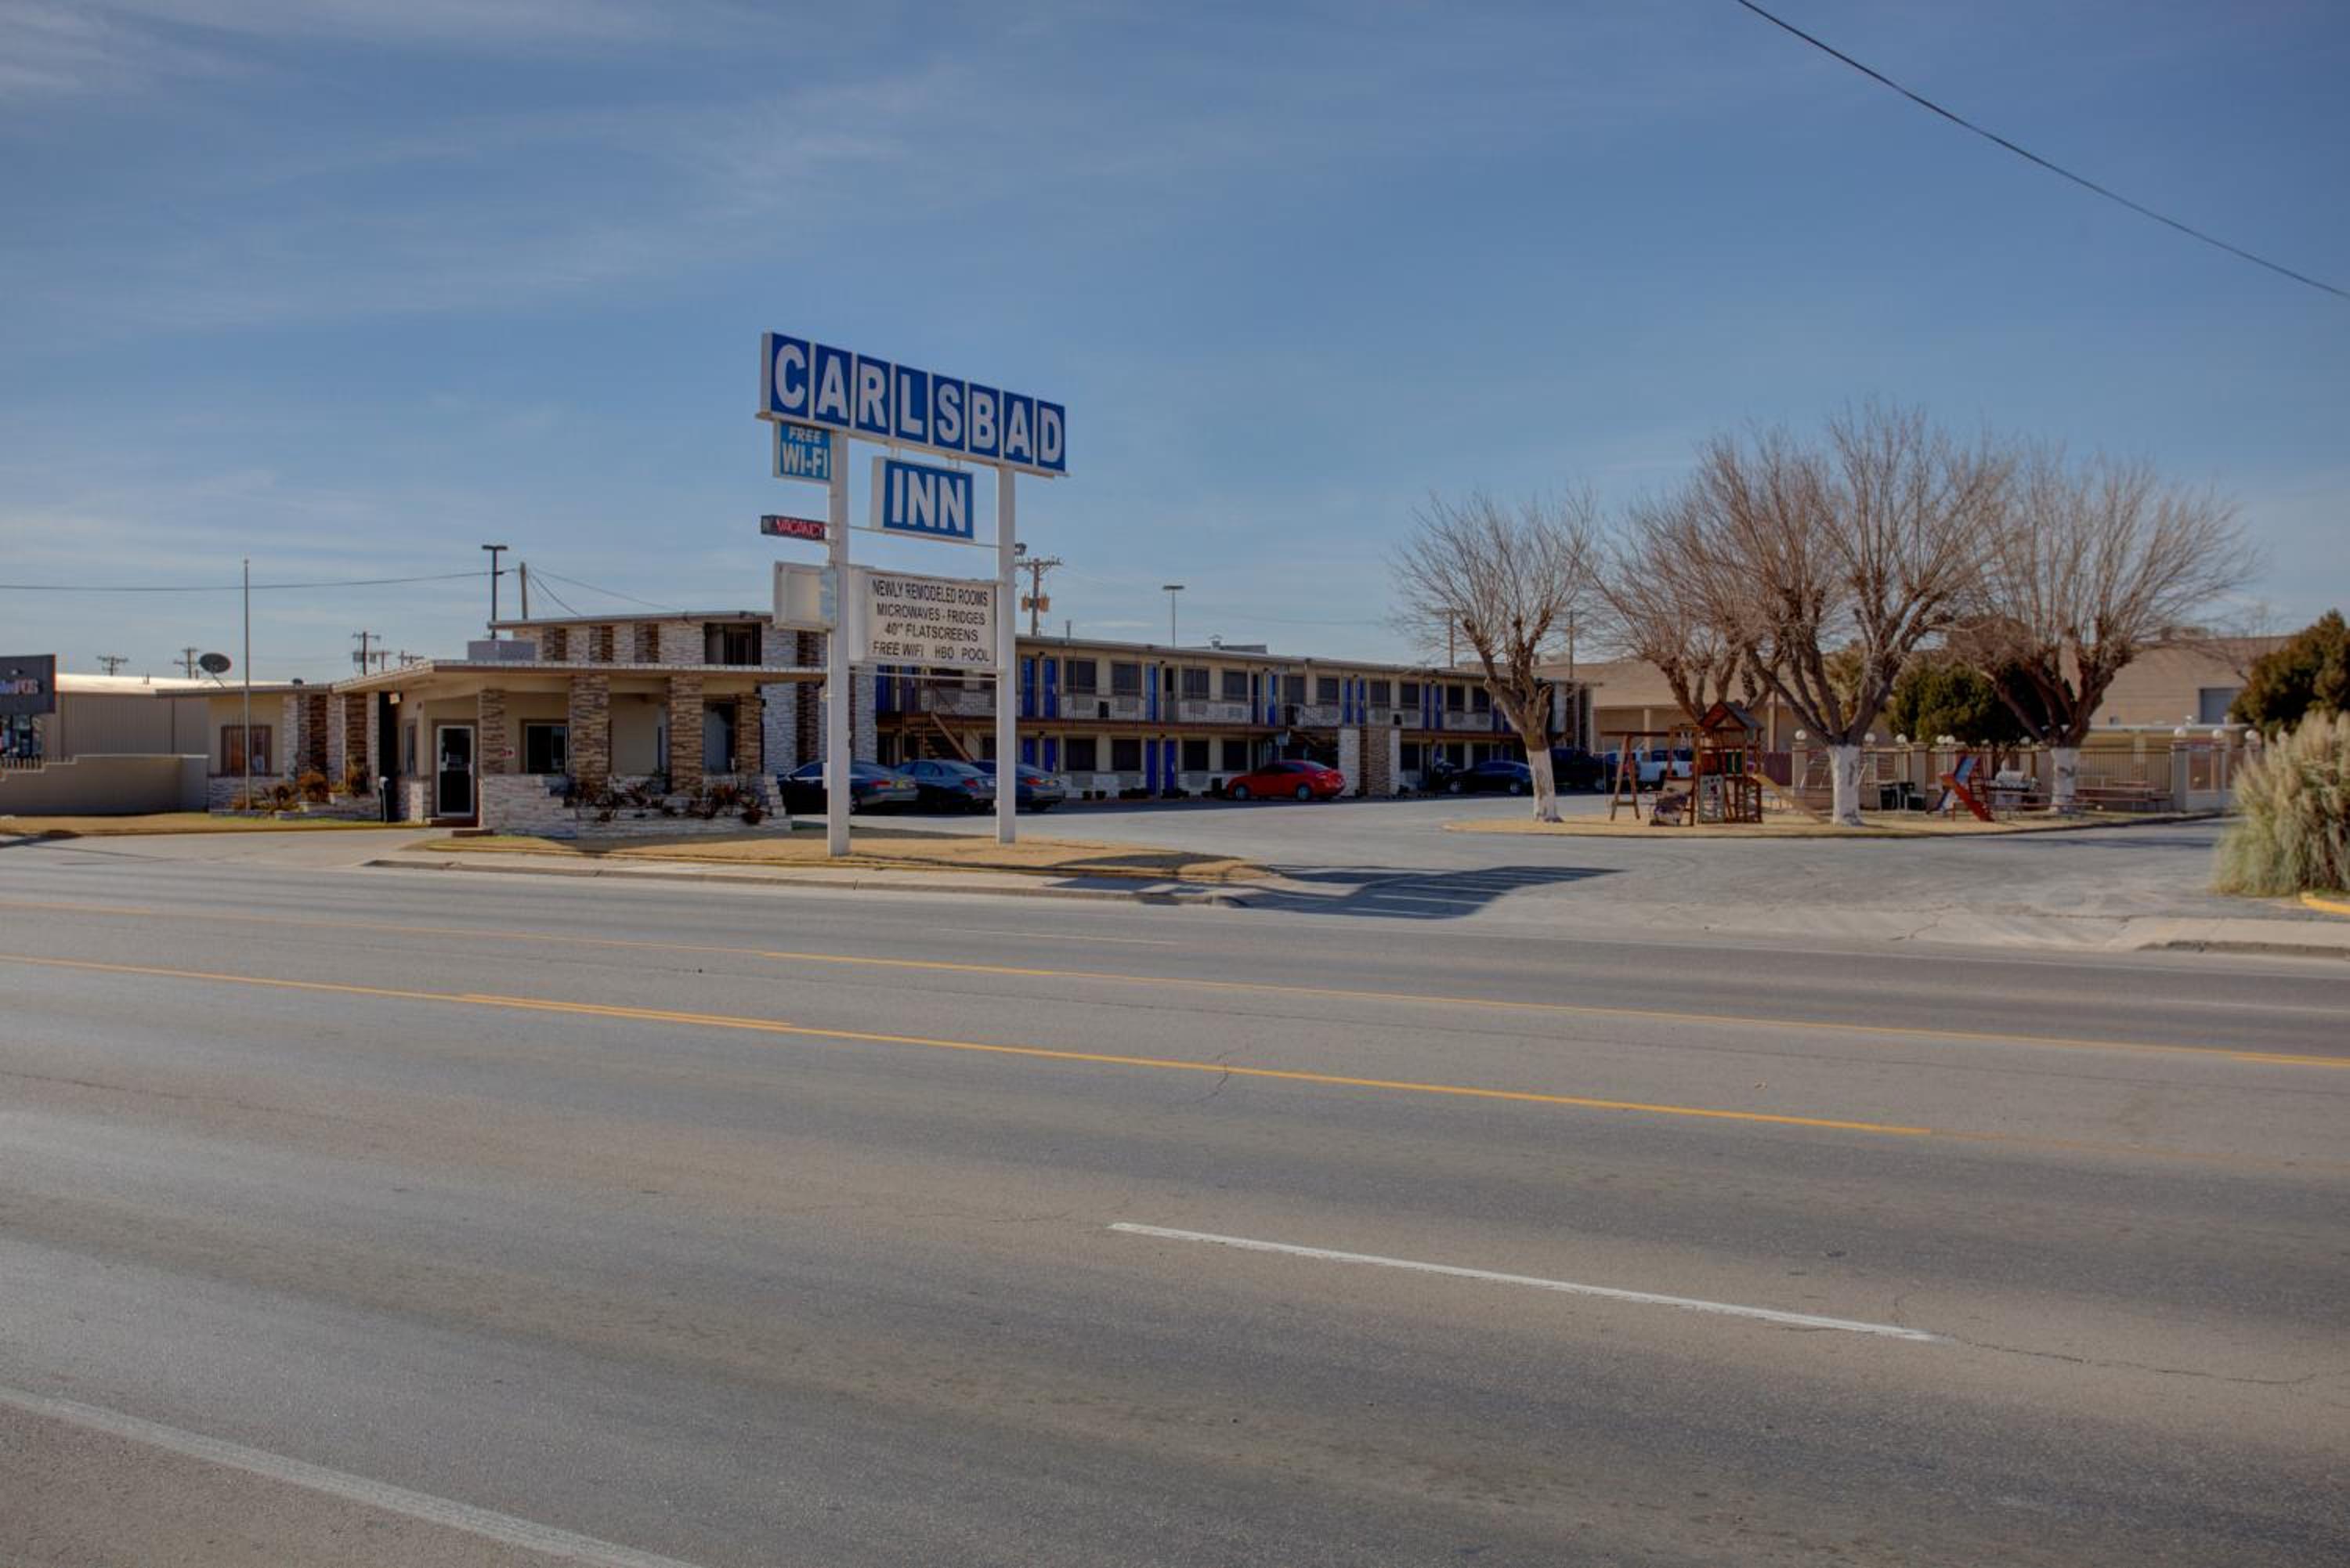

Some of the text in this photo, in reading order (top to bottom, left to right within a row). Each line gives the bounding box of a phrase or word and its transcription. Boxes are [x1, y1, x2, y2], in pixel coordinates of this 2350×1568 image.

[774, 343, 1063, 463] CARLSBAD
[789, 426, 822, 444] FREE
[891, 468, 965, 532] INN
[776, 518, 826, 539] VACANCY
[873, 580, 988, 606] NEWLY REMODELED ROOMS
[877, 602, 940, 621] MICROWAVES
[947, 609, 985, 625] FRIDGES
[906, 623, 978, 641] FLATSCREENS
[873, 641, 990, 662] FREE WIFI HBO POOL
